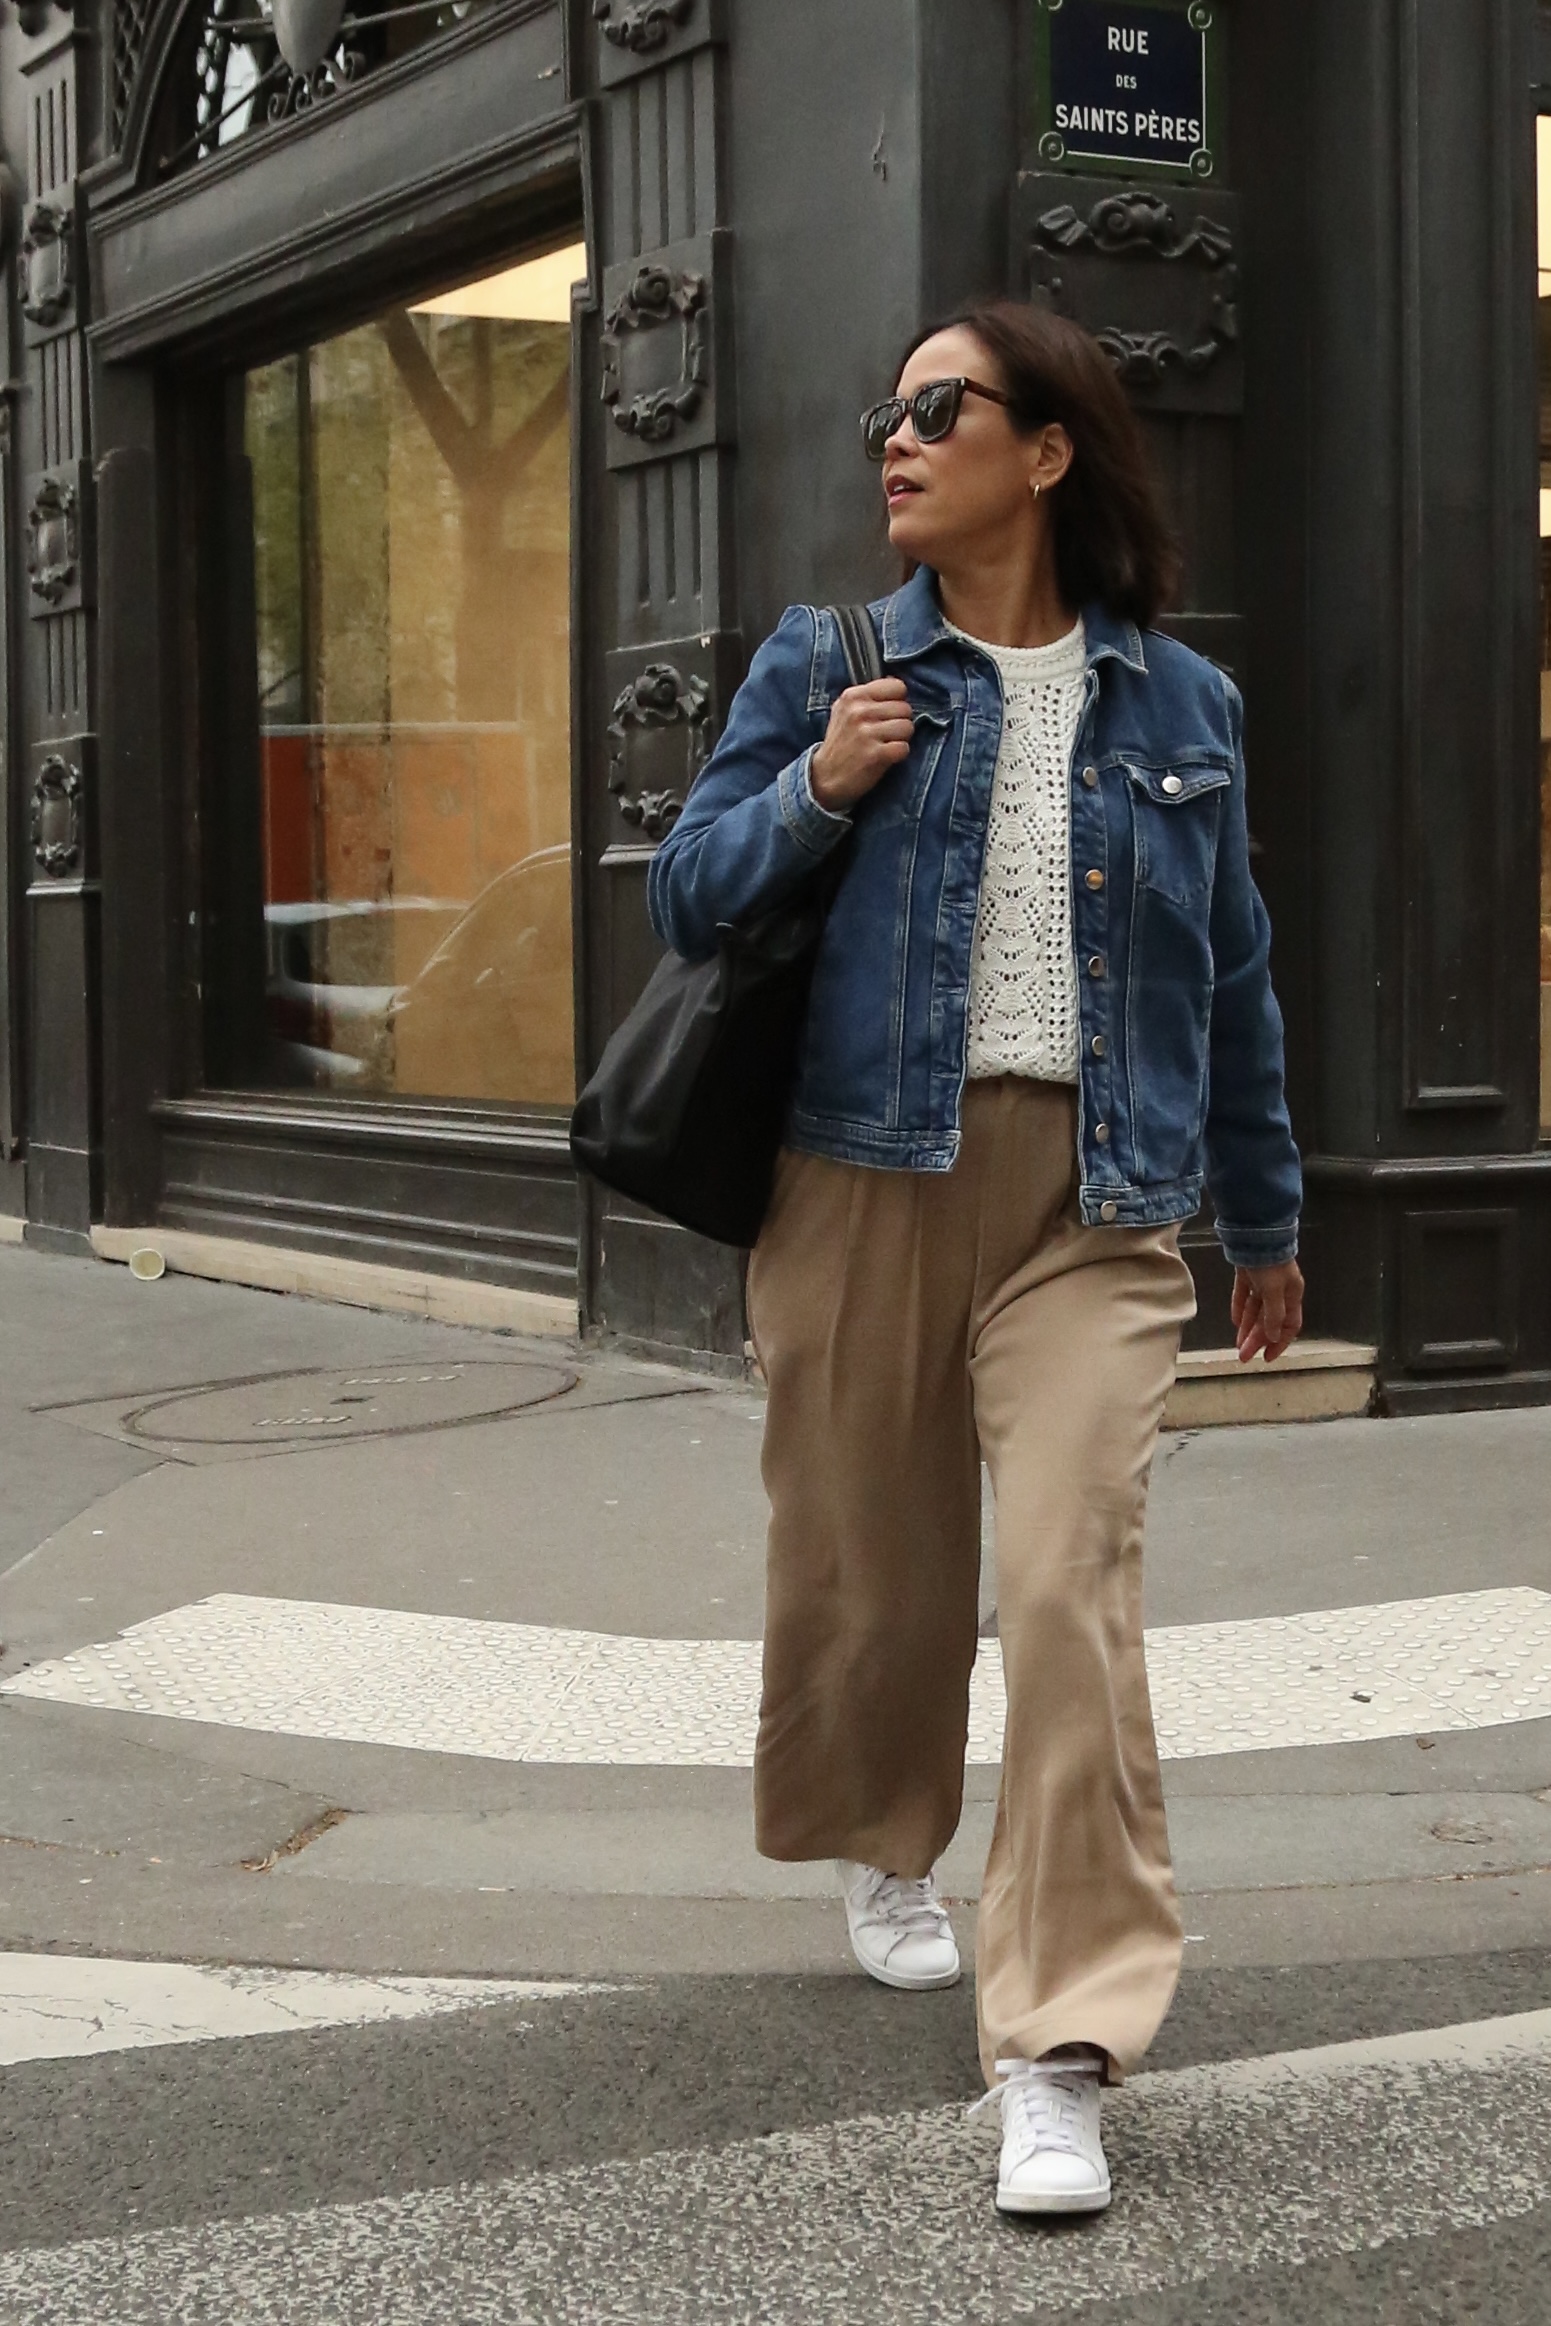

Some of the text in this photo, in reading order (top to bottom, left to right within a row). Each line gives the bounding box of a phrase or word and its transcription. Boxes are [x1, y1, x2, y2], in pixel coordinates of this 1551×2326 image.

[1107, 26, 1149, 55] RUE
[1115, 74, 1137, 89] DES
[1055, 103, 1200, 143] SAINTS PÈRES
